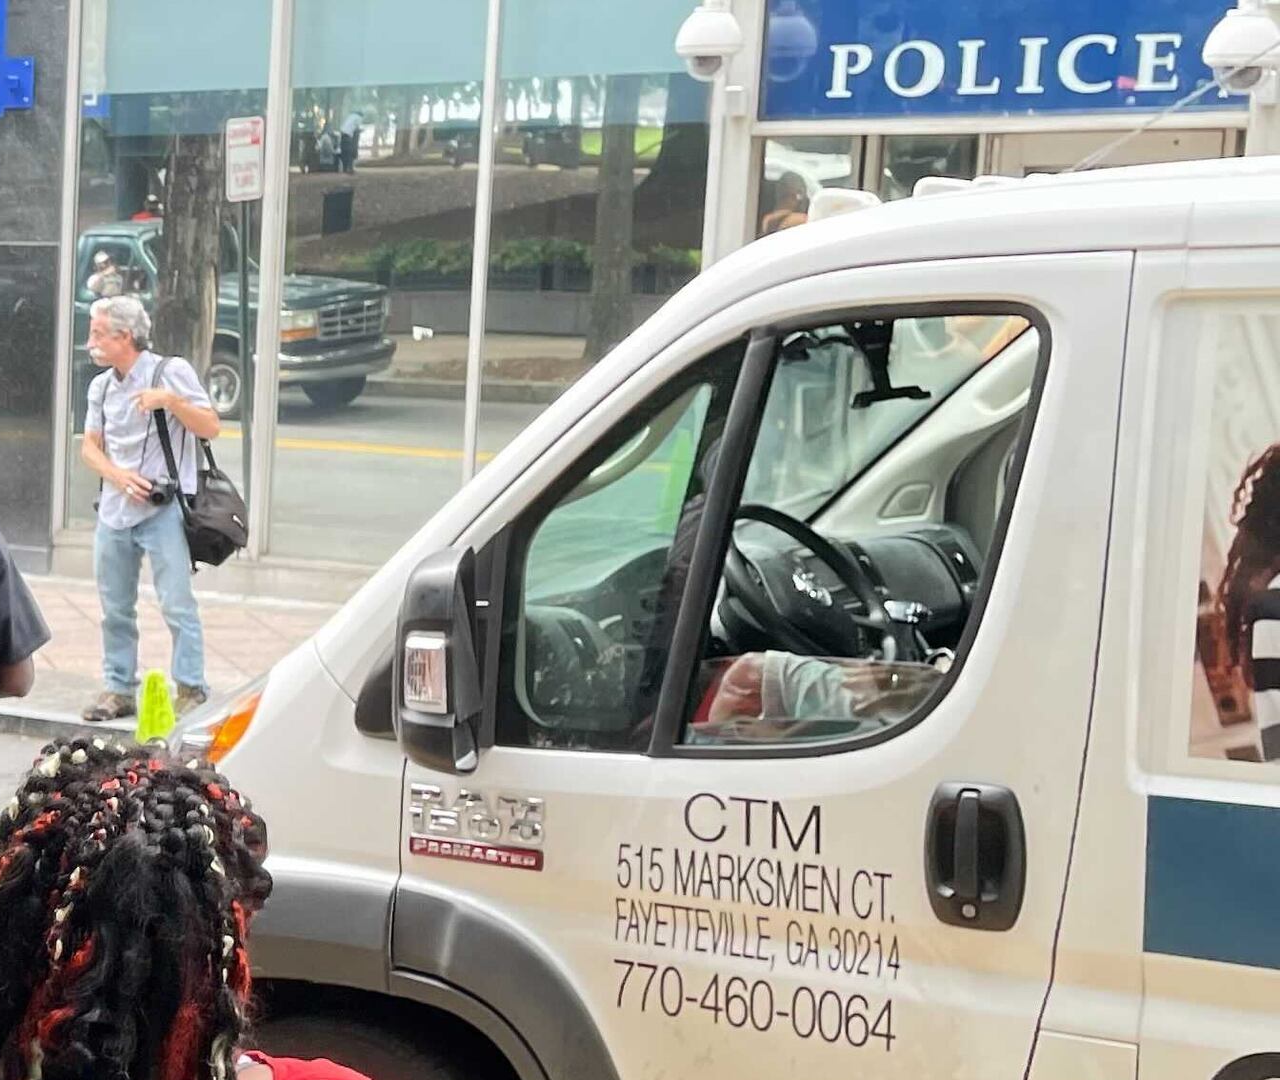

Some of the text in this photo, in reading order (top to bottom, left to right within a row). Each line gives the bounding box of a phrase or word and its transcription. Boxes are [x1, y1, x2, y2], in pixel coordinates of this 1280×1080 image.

[825, 33, 1183, 100] POLICE
[684, 793, 822, 855] CTM
[616, 844, 895, 924] 515 MARKSMEN CT.
[614, 897, 901, 981] FAYETTEVILLE, GA 30214
[613, 959, 896, 1052] 770-460-0064
